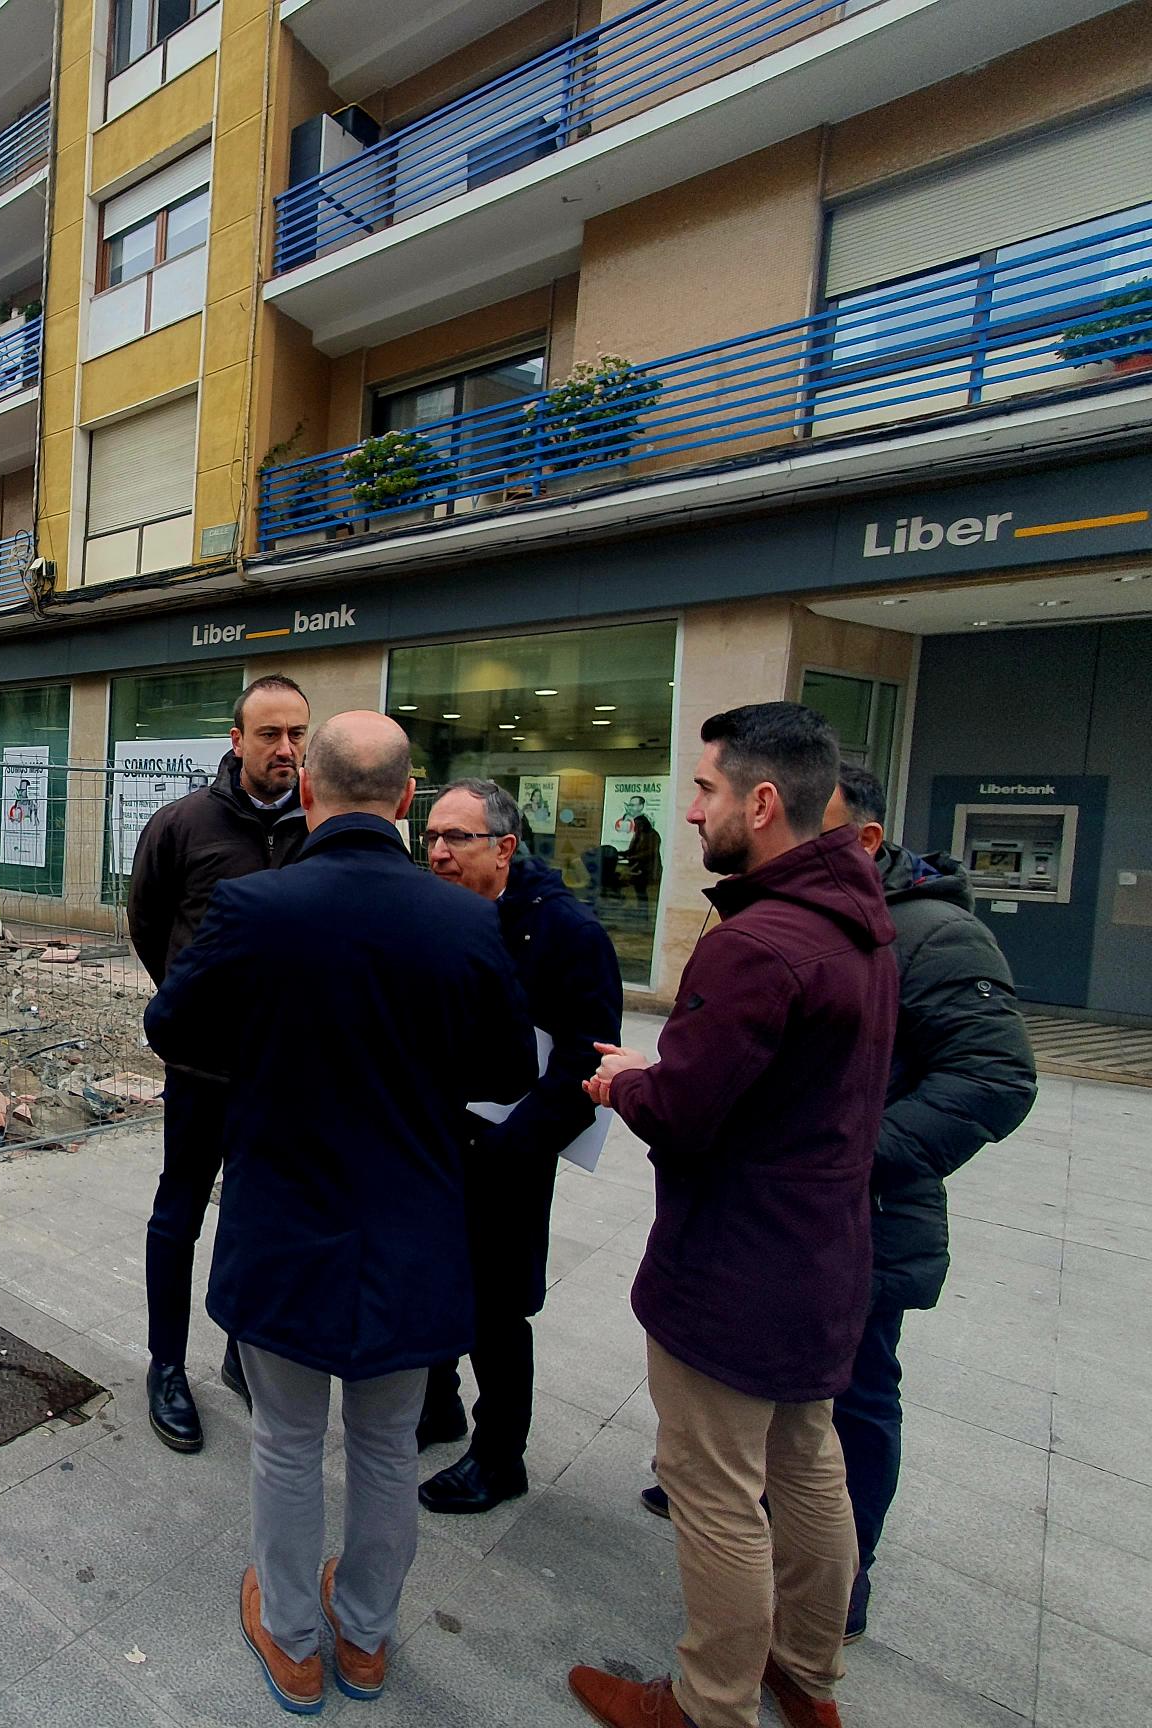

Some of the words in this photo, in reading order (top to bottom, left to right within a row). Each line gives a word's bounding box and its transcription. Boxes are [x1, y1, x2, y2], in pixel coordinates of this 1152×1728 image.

[862, 511, 1013, 557] Liber
[192, 623, 246, 646] Liber
[293, 603, 356, 633] bank
[124, 758, 163, 778] SOMOS
[166, 754, 193, 778] MÁS
[615, 783, 641, 793] SOMOS
[643, 782, 662, 793] MÁS
[979, 784, 1056, 795] Liberbank
